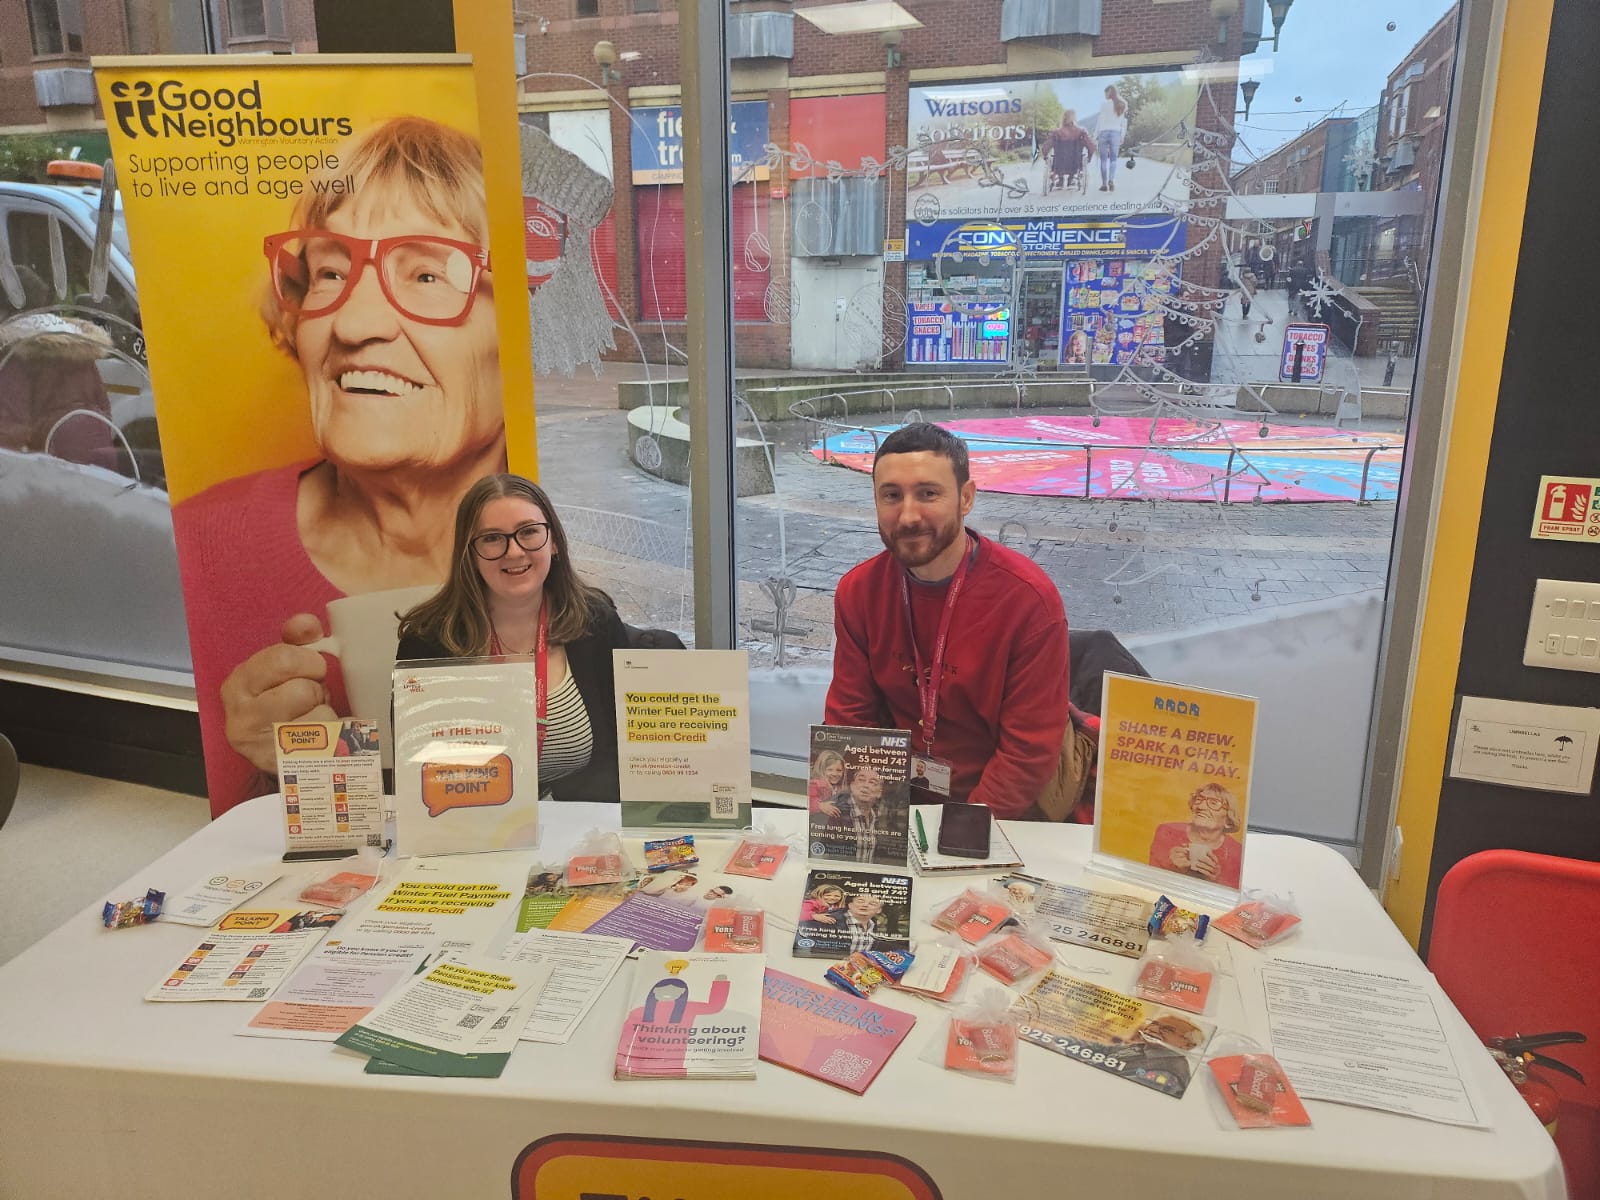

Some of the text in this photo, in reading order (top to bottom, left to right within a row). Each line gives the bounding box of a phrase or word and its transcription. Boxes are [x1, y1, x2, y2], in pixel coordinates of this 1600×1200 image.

[158, 80, 262, 111] Good
[924, 97, 1022, 118] Watsons
[162, 112, 353, 147] Neighbours
[657, 111, 682, 138] fie
[658, 141, 683, 166] tre
[130, 150, 339, 177] Supporting people
[132, 175, 355, 199] to live and age well
[949, 205, 982, 215] solicitors
[983, 204, 1003, 214] have
[1005, 205, 1022, 213] over
[1024, 204, 1034, 213] 35
[1062, 202, 1108, 214] experience
[1110, 200, 1143, 213] dealing
[1027, 222, 1054, 231] MR
[959, 229, 1126, 244] CONVENIENCE
[1021, 243, 1061, 251] STORE
[914, 316, 943, 324] TOBACCO
[914, 326, 939, 334] SNACKS
[626, 693, 720, 706] You could get the
[627, 706, 737, 719] Winter Fuel Payment
[627, 719, 728, 731] if you are receiving
[431, 728, 444, 737] IN
[449, 727, 472, 737] THE
[628, 731, 707, 742] Pension Credit
[1119, 721, 1236, 748] SHARE A BREW.
[881, 736, 908, 747] NHS
[844, 744, 908, 757] Aged between
[1117, 736, 1233, 764] SPARK A CHAT.
[858, 755, 907, 766] 55 and 74?
[1110, 749, 1241, 780] BRIGHTEN A DAY.
[844, 763, 872, 772] Current
[882, 766, 907, 775] former
[445, 780, 491, 795] POINT
[810, 823, 826, 831] Free
[826, 824, 842, 833] lung
[890, 829, 902, 837] are
[810, 831, 835, 841] coming
[836, 833, 844, 841] to
[844, 834, 857, 843] you
[401, 882, 498, 892] You could get the
[869, 882, 908, 891] between
[882, 877, 909, 886] NHS
[392, 890, 510, 901] Winter Fuel Payment
[377, 904, 466, 915] Pension Credit
[394, 898, 417, 906] you
[440, 900, 496, 909] receiving
[1052, 924, 1145, 952] 25 246881
[440, 963, 512, 983] Are you over State
[432, 968, 464, 982] Pension
[494, 982, 517, 992] know
[463, 983, 481, 993] who
[1070, 977, 1095, 990] never
[1094, 984, 1132, 1004] watched
[764, 975, 885, 1023] NTERESTED IN
[1093, 998, 1117, 1010] great
[766, 988, 896, 1037] LUNTEERING?
[1124, 1003, 1140, 1012] my
[1106, 1009, 1135, 1022] switch
[632, 1023, 748, 1037] Thinking about
[638, 1035, 746, 1047] volunteering?
[1055, 1038, 1128, 1072] 246881
